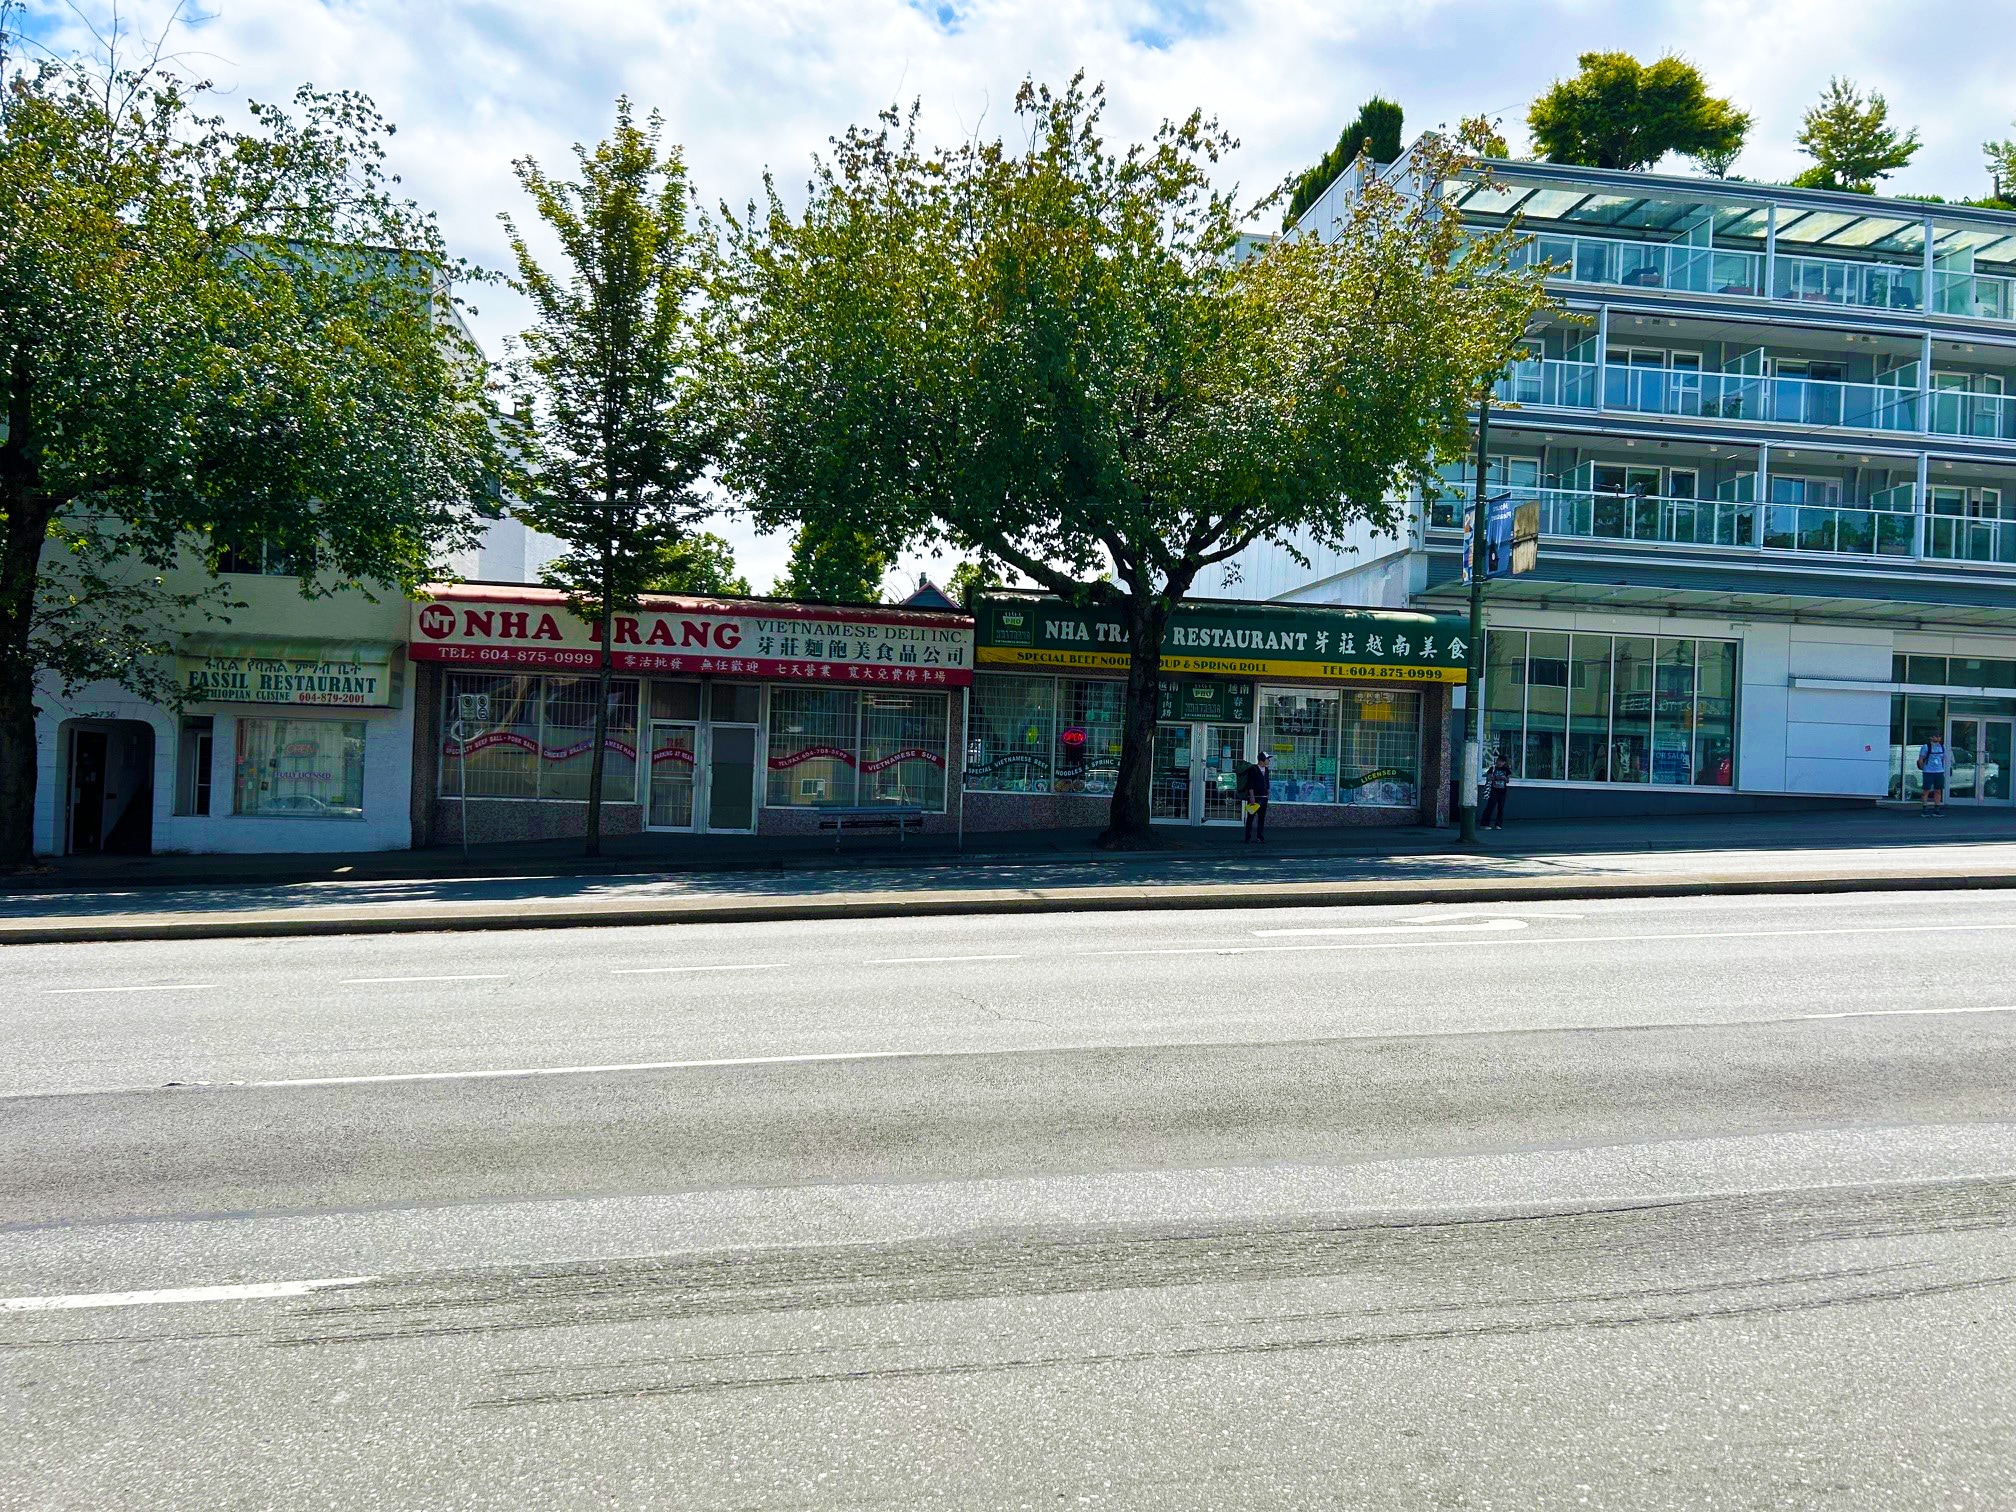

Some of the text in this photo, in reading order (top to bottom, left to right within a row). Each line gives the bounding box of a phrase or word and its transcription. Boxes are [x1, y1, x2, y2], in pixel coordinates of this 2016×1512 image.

[463, 610, 563, 640] NHA
[755, 619, 967, 644] VIETNAMESE DELI INC.
[1045, 620, 1090, 641] NHA
[1173, 626, 1308, 651] RESTAURANT
[1314, 630, 1469, 660] 芽莊越南美食
[438, 646, 594, 664] TEL: 604-875-0999
[1017, 651, 1067, 664] SPECIAL
[1070, 655, 1098, 664] BEEF
[1101, 656, 1132, 666] NOOD
[1159, 659, 1182, 668] OUP
[1184, 660, 1190, 668] &
[1193, 660, 1237, 670] SPRING
[1240, 662, 1268, 672] ROLL
[260, 674, 377, 694] RESTAURANT
[203, 689, 250, 699] THIOPIAN
[299, 692, 365, 704] 604-879-2001
[445, 745, 474, 754] SPECLTY
[868, 750, 938, 772] VIETNAMESE SUB
[968, 766, 992, 774] SPECIAL
[994, 755, 1032, 767] VIETNAMESE
[1360, 769, 1397, 783] LICENSED
